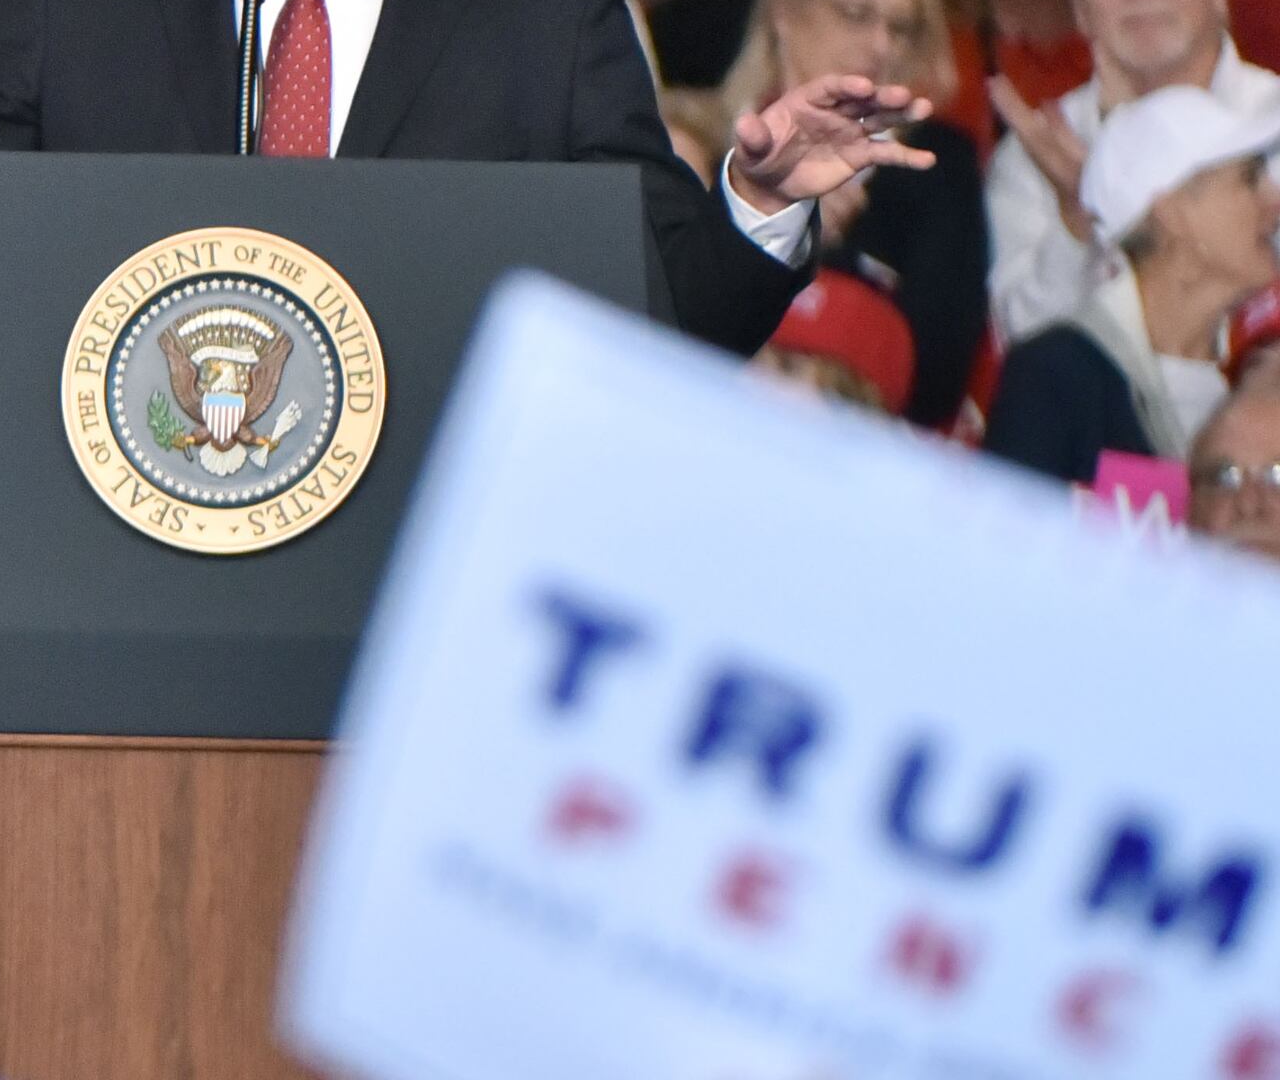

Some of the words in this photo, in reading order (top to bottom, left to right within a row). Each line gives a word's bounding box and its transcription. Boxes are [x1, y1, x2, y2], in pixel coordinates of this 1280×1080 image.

[233, 244, 263, 265] OF
[269, 251, 308, 285] THE
[74, 240, 223, 378] PRESIDENT
[313, 282, 375, 415] UNITED
[77, 388, 96, 433] THE
[87, 440, 113, 466] OF
[111, 469, 190, 534] SEAL
[246, 443, 359, 537] STATES
[530, 576, 1262, 954] TRUM
